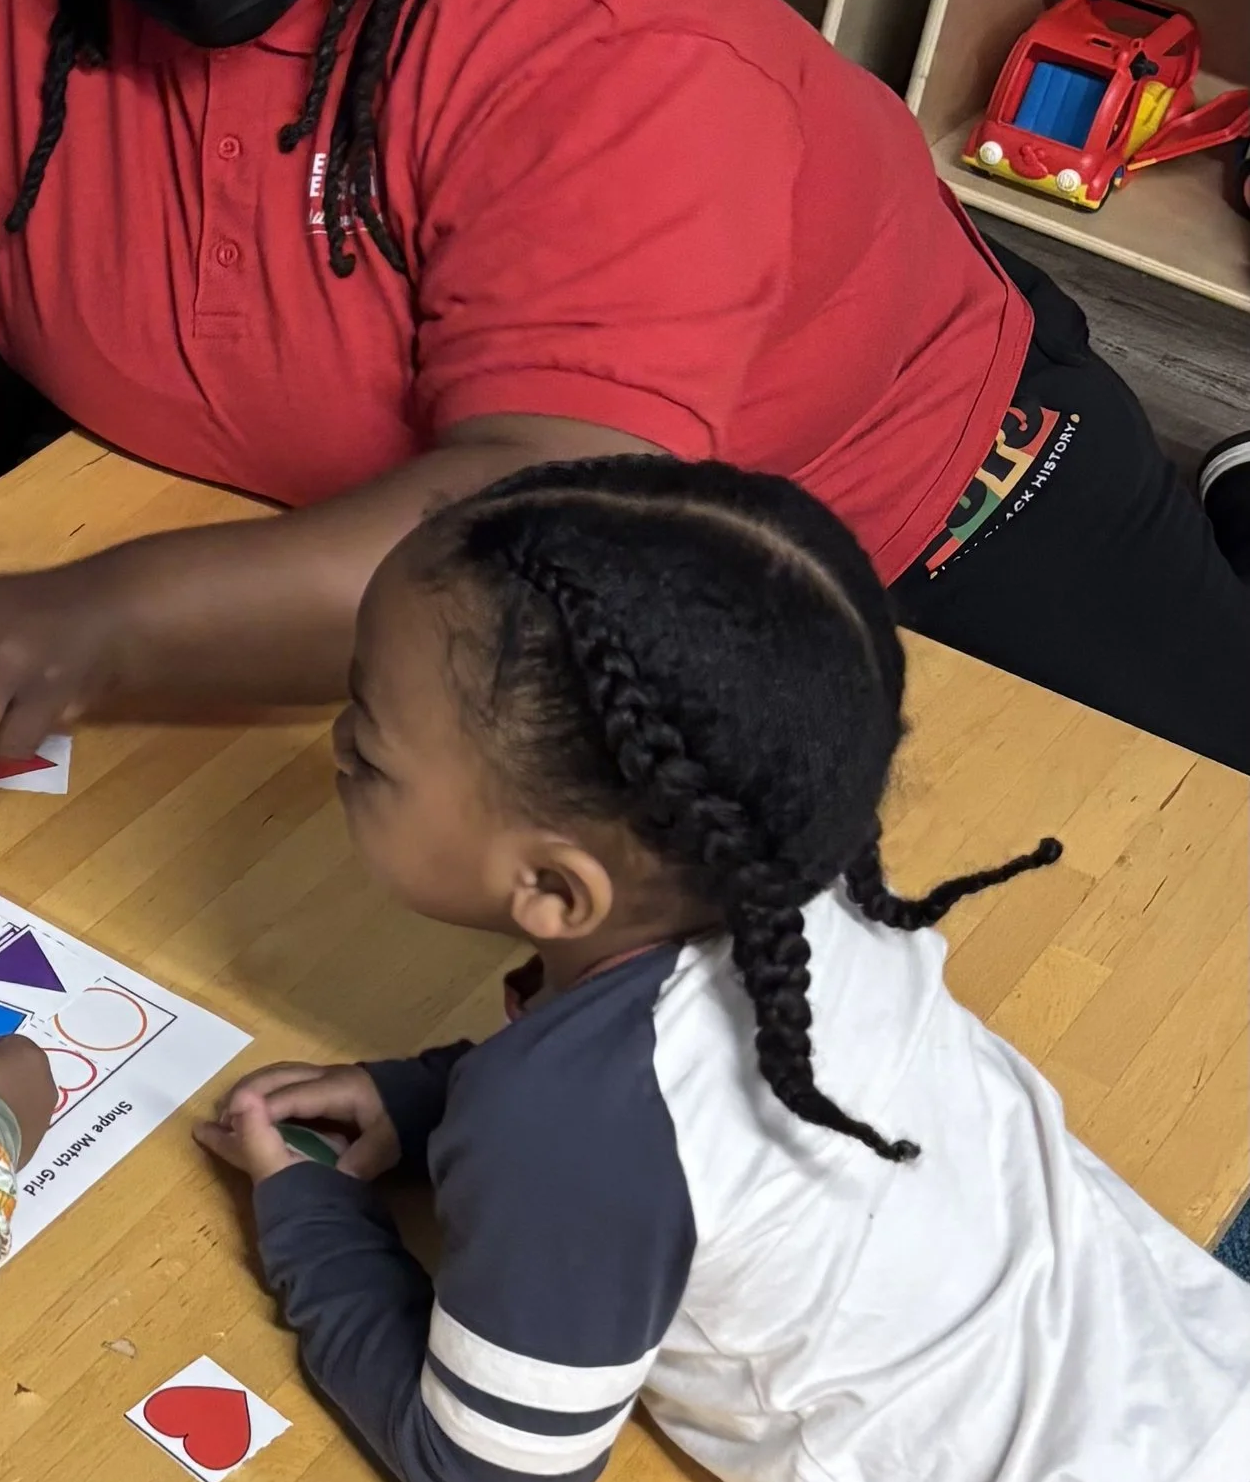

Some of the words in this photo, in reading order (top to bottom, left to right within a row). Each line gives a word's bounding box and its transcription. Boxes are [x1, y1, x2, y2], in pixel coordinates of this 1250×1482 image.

[1030, 422, 1077, 489] HISTORY
[91, 1100, 133, 1133] Shape
[52, 1133, 96, 1167] Match
[22, 1168, 56, 1197] Grid
